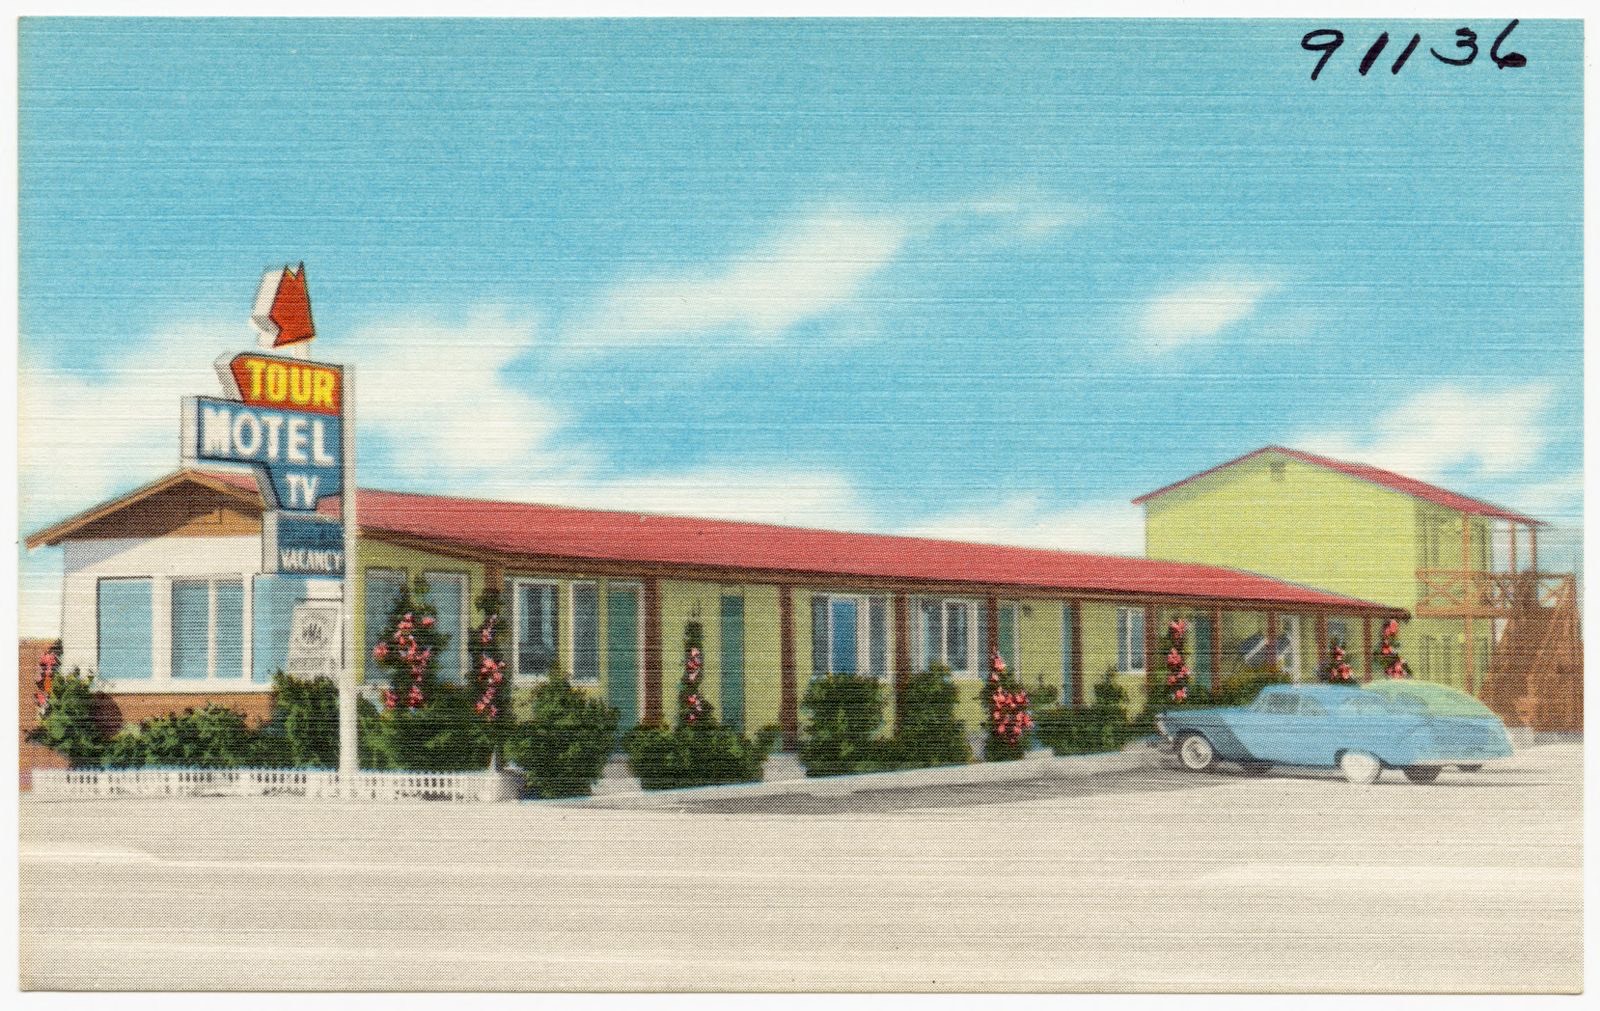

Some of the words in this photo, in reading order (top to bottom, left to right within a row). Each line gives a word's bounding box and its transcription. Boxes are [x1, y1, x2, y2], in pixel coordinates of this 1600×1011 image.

[1301, 19, 1527, 80] 91136
[244, 359, 335, 410] TOUR
[203, 406, 334, 466] MOTEL
[285, 473, 319, 509] TV
[280, 548, 342, 571] VACANCY
